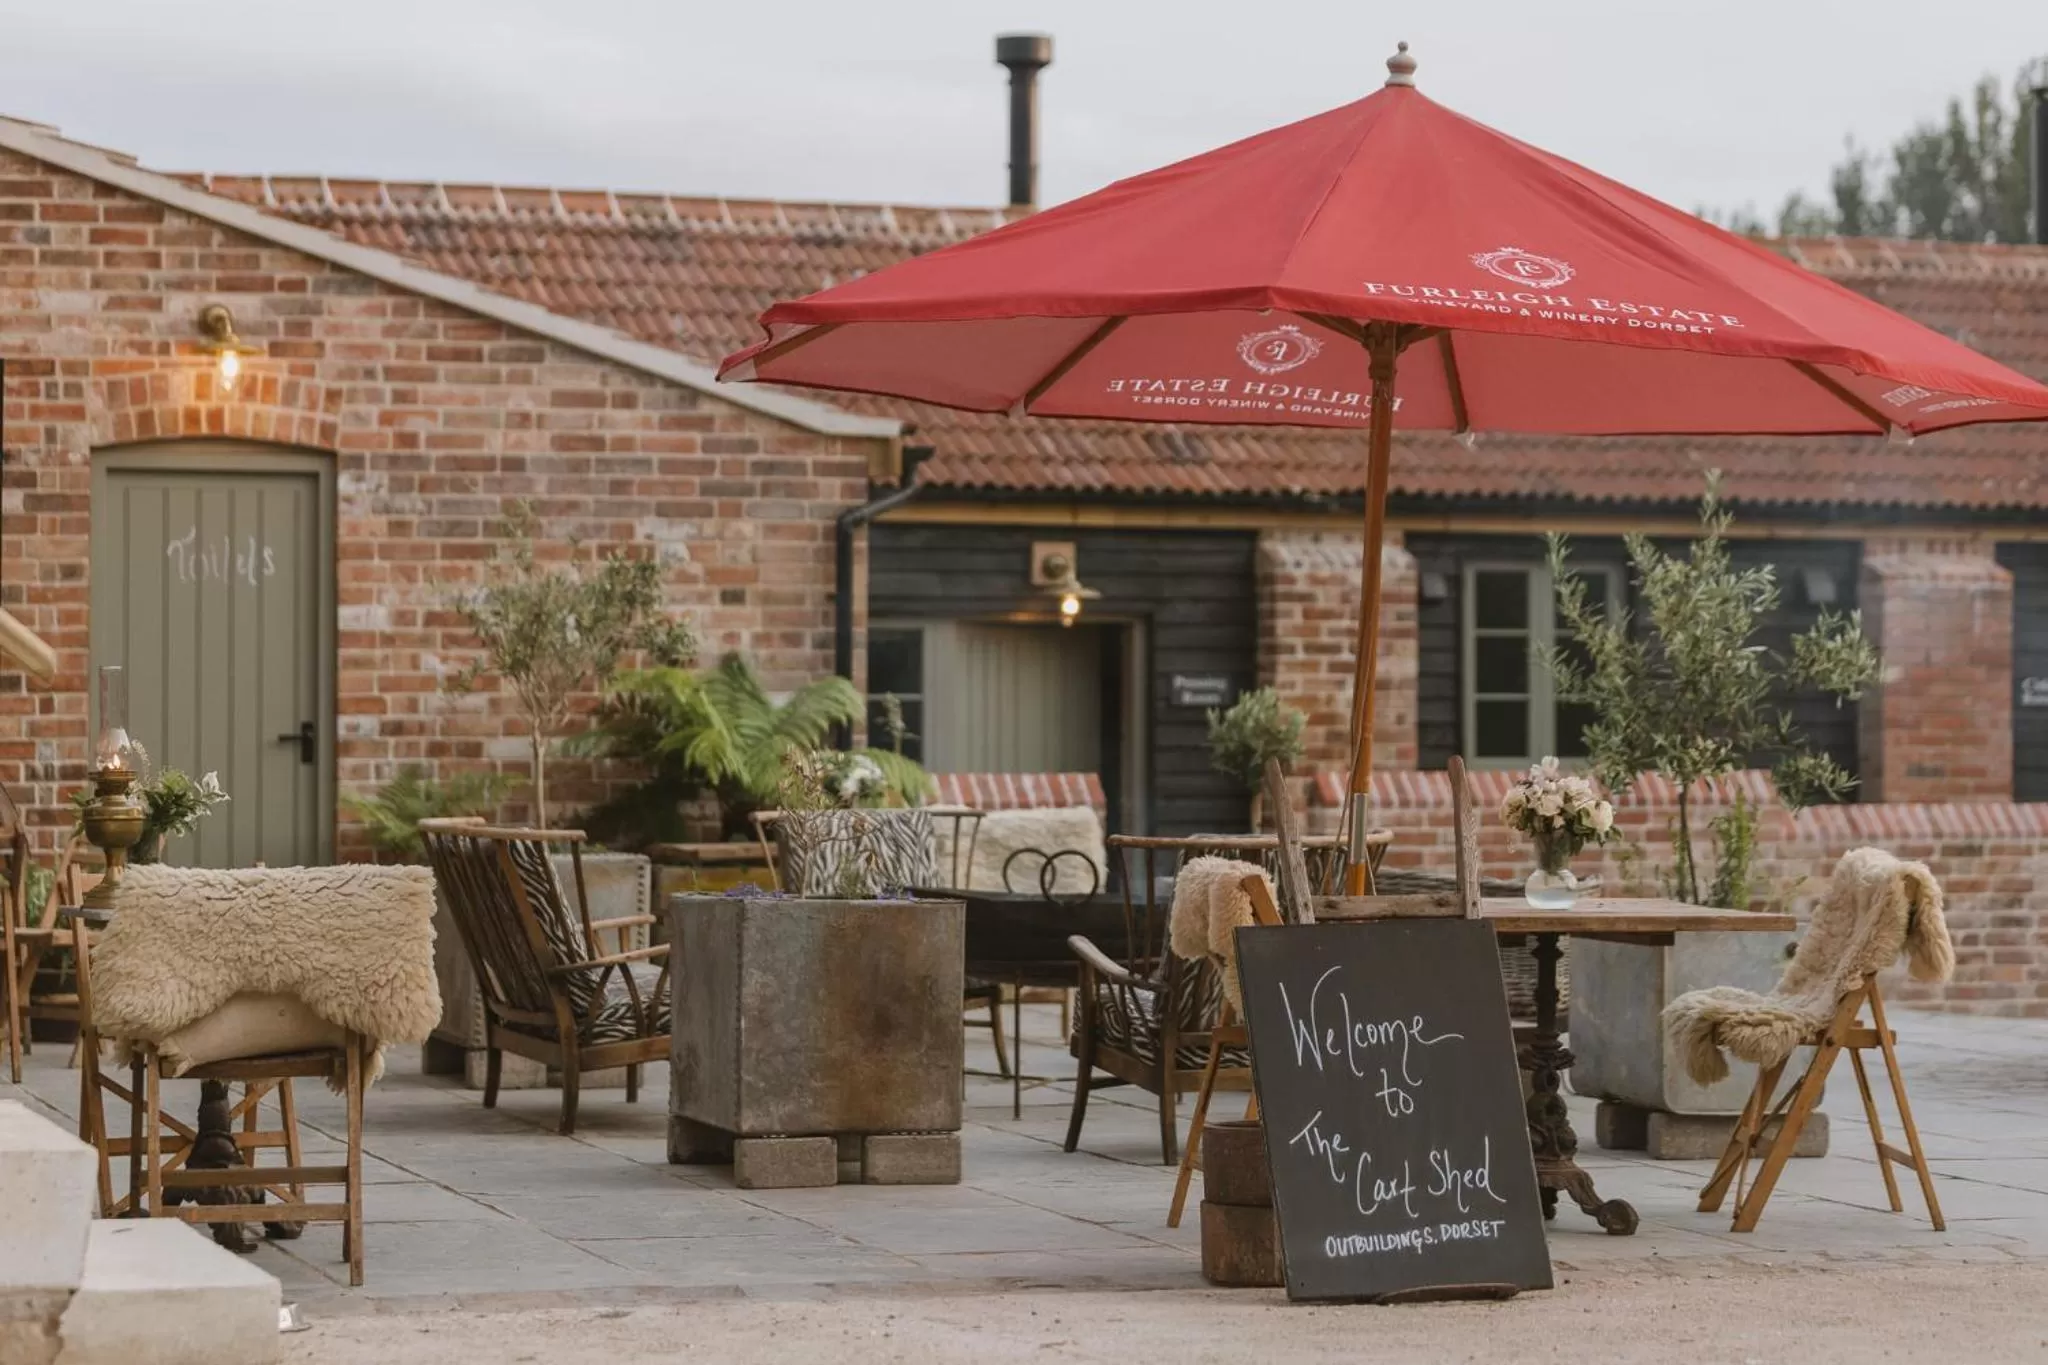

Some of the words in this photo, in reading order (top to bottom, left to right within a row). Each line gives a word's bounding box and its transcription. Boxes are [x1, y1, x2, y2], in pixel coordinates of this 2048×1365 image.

[1364, 281, 1574, 307] FURLEIGH
[1587, 298, 1745, 328] ESTATE
[1519, 307, 1532, 317] &
[1539, 310, 1619, 325] WINERY
[1627, 318, 1715, 334] DORSET
[1279, 965, 1465, 1086] Welcome
[1375, 1067, 1414, 1117] to
[1289, 1110, 1350, 1183] The
[1356, 1152, 1420, 1217] Cart
[1427, 1135, 1507, 1213] Shed
